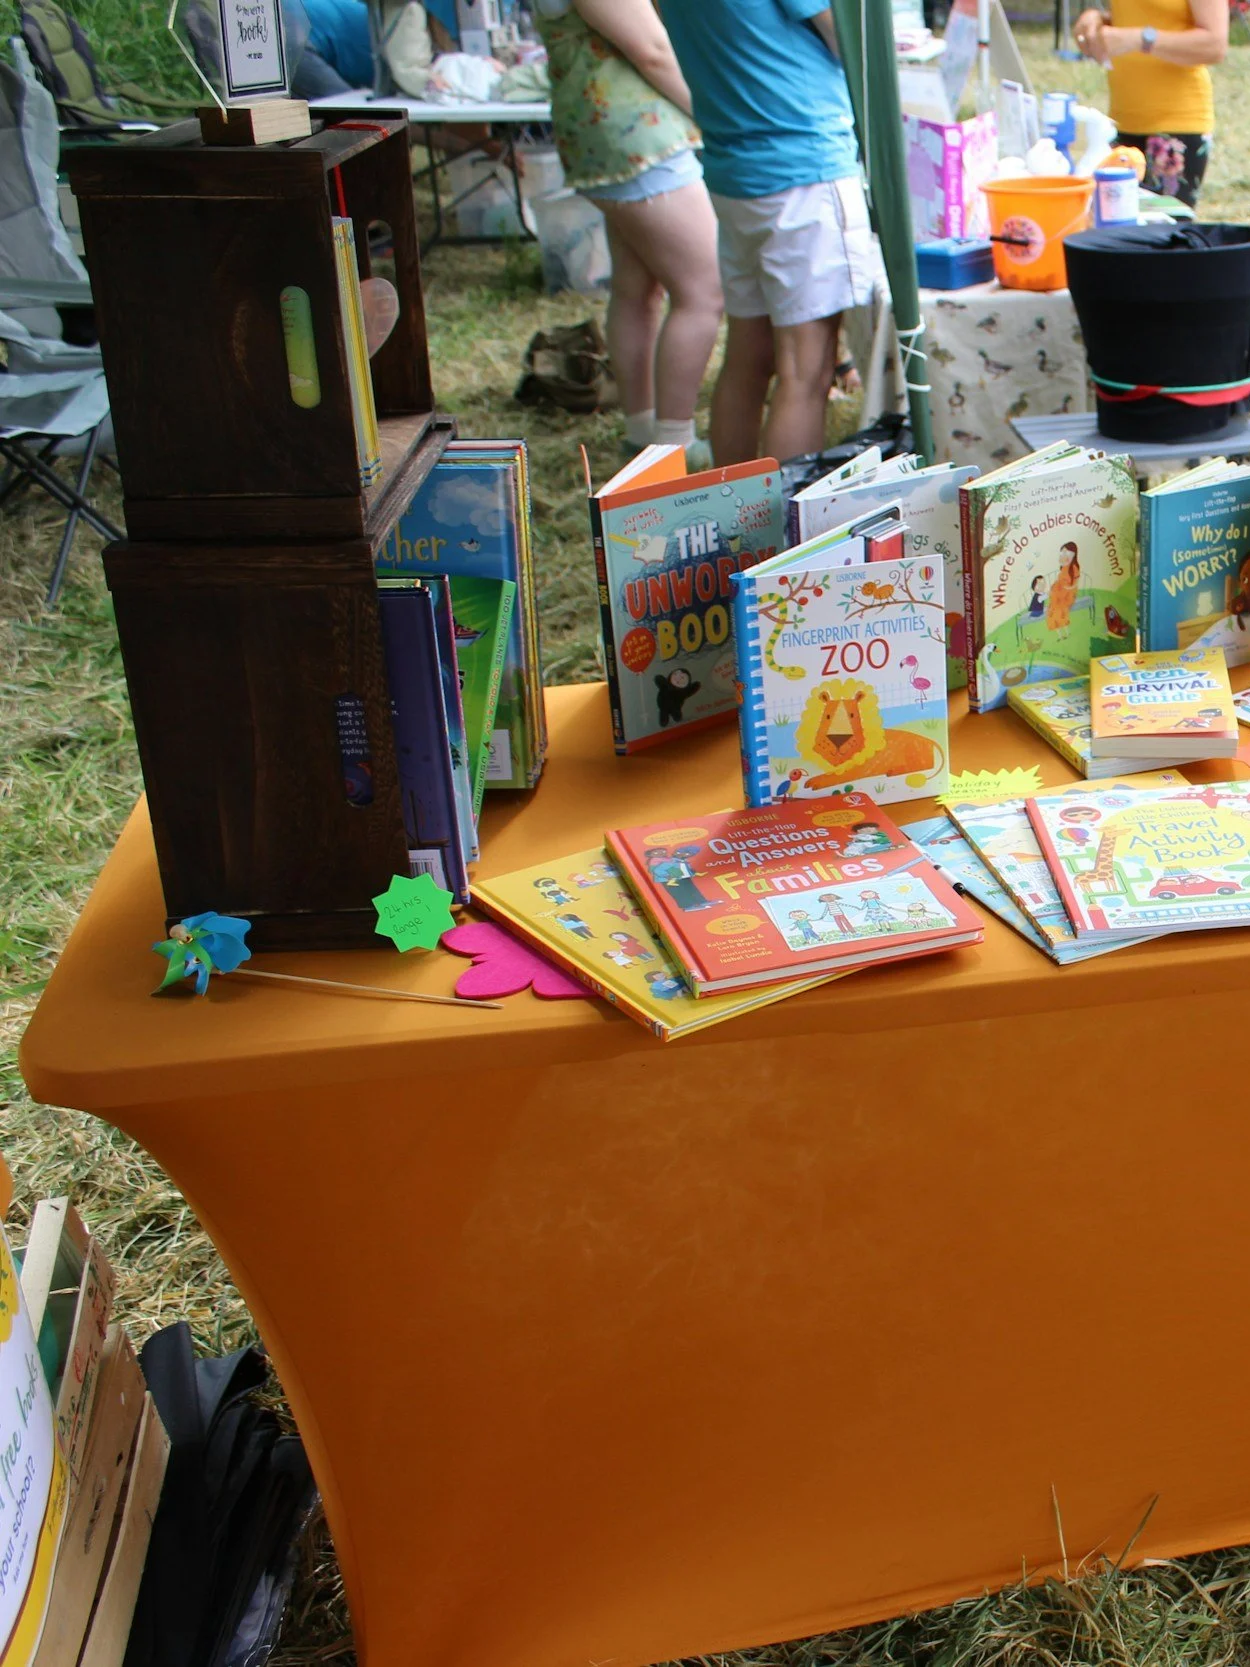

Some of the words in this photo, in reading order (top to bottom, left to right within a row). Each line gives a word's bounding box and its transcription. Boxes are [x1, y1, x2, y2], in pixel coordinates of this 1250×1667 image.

[674, 493, 710, 508] Usborne
[1023, 496, 1058, 509] Questions
[1074, 485, 1103, 496] Answers
[1031, 482, 1077, 497] Lift-the-flap
[675, 521, 720, 560] THE
[1191, 524, 1223, 544] Why
[1225, 523, 1241, 540] do
[1243, 525, 1248, 539] I
[934, 540, 959, 565] die?
[992, 556, 1015, 609] Where
[1012, 536, 1029, 555] do
[1029, 512, 1073, 538] babies
[1102, 533, 1124, 577] from?
[835, 571, 867, 582] USBORNE
[963, 572, 972, 597] Where
[1162, 548, 1237, 597] WORRY?
[657, 604, 729, 661] BOO
[781, 624, 860, 648] FINGERPRINT
[865, 616, 926, 637] ACTIVITIES
[820, 638, 890, 676] ZOO
[1122, 668, 1190, 681] Teen
[1104, 680, 1219, 696] SURVIVAL
[1128, 692, 1198, 704] Guide
[727, 813, 779, 827] USBORNE
[728, 822, 796, 839] Lift-the-flap
[1137, 816, 1219, 834] Travel
[708, 827, 830, 856] Questions
[1128, 830, 1246, 849] Activity
[705, 856, 736, 868] and
[739, 839, 841, 868] Answers
[1153, 844, 1236, 863] Book
[713, 856, 885, 900] Families
[746, 863, 794, 878] about
[383, 904, 401, 919] 24
[401, 895, 422, 908] hrs
[16, 1352, 39, 1429] books
[0, 1536, 15, 1596] your
[12, 1455, 36, 1538] school?
